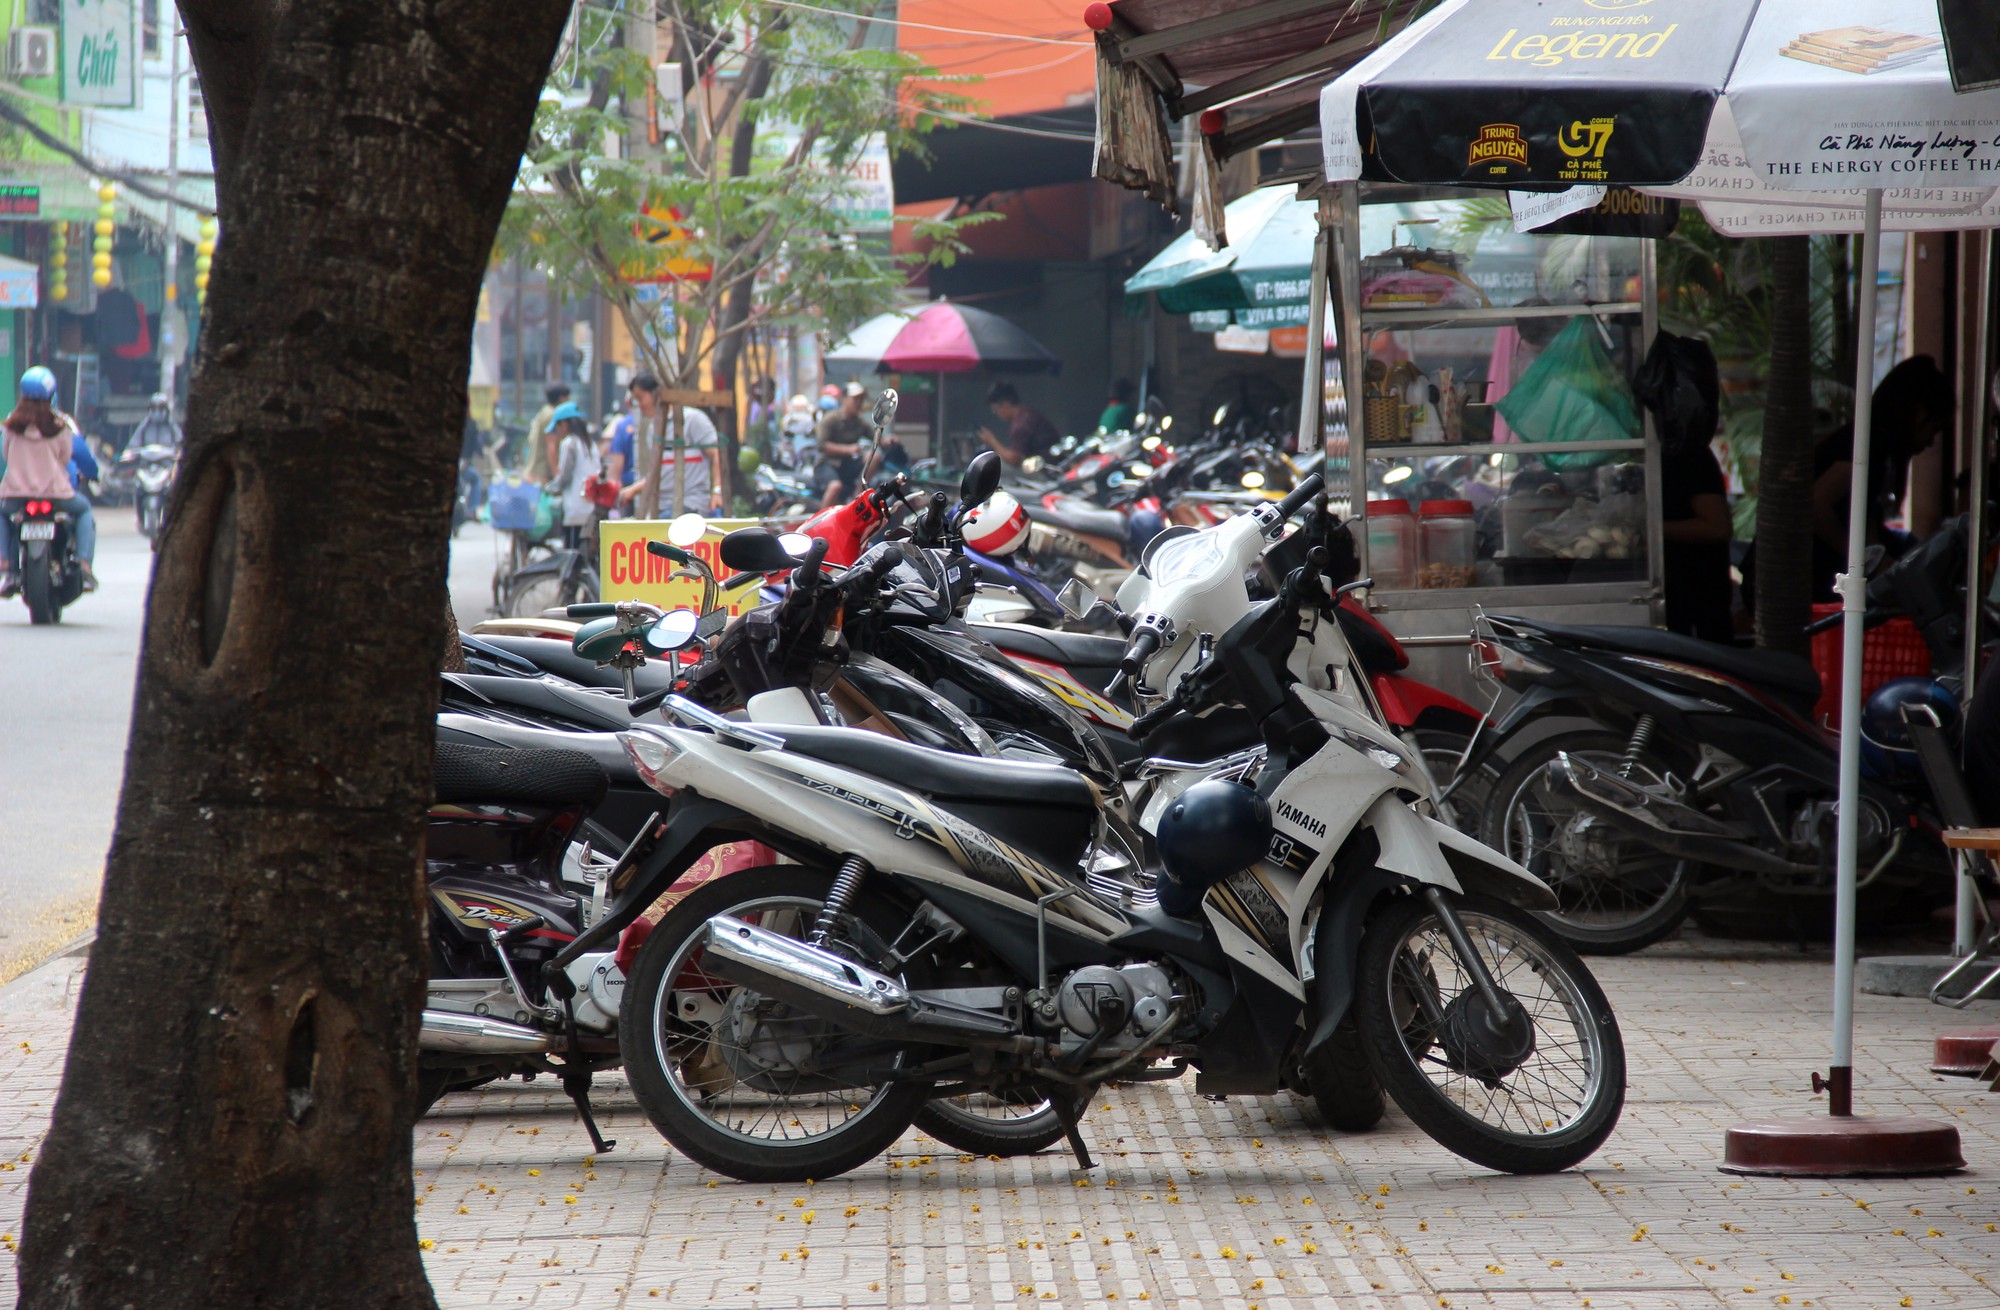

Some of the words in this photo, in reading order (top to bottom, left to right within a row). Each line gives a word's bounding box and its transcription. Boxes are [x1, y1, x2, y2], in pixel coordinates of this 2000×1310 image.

[1550, 17, 1596, 26] TRUNG
[1485, 24, 1679, 66] Legend
[1484, 127, 1515, 139] TRUNG
[1472, 139, 1525, 159] NGUYÊN
[1846, 133, 1874, 150] Phê
[1567, 159, 1579, 169] CÀ
[1582, 158, 1602, 169] PHÊ
[1767, 162, 1803, 175] THE
[1811, 160, 1884, 174] ENERGY
[1891, 159, 1960, 172] COFFEE
[1580, 170, 1609, 181] THIỆT
[803, 776, 897, 817] TAURUS
[1276, 799, 1327, 838] YAMAHA
